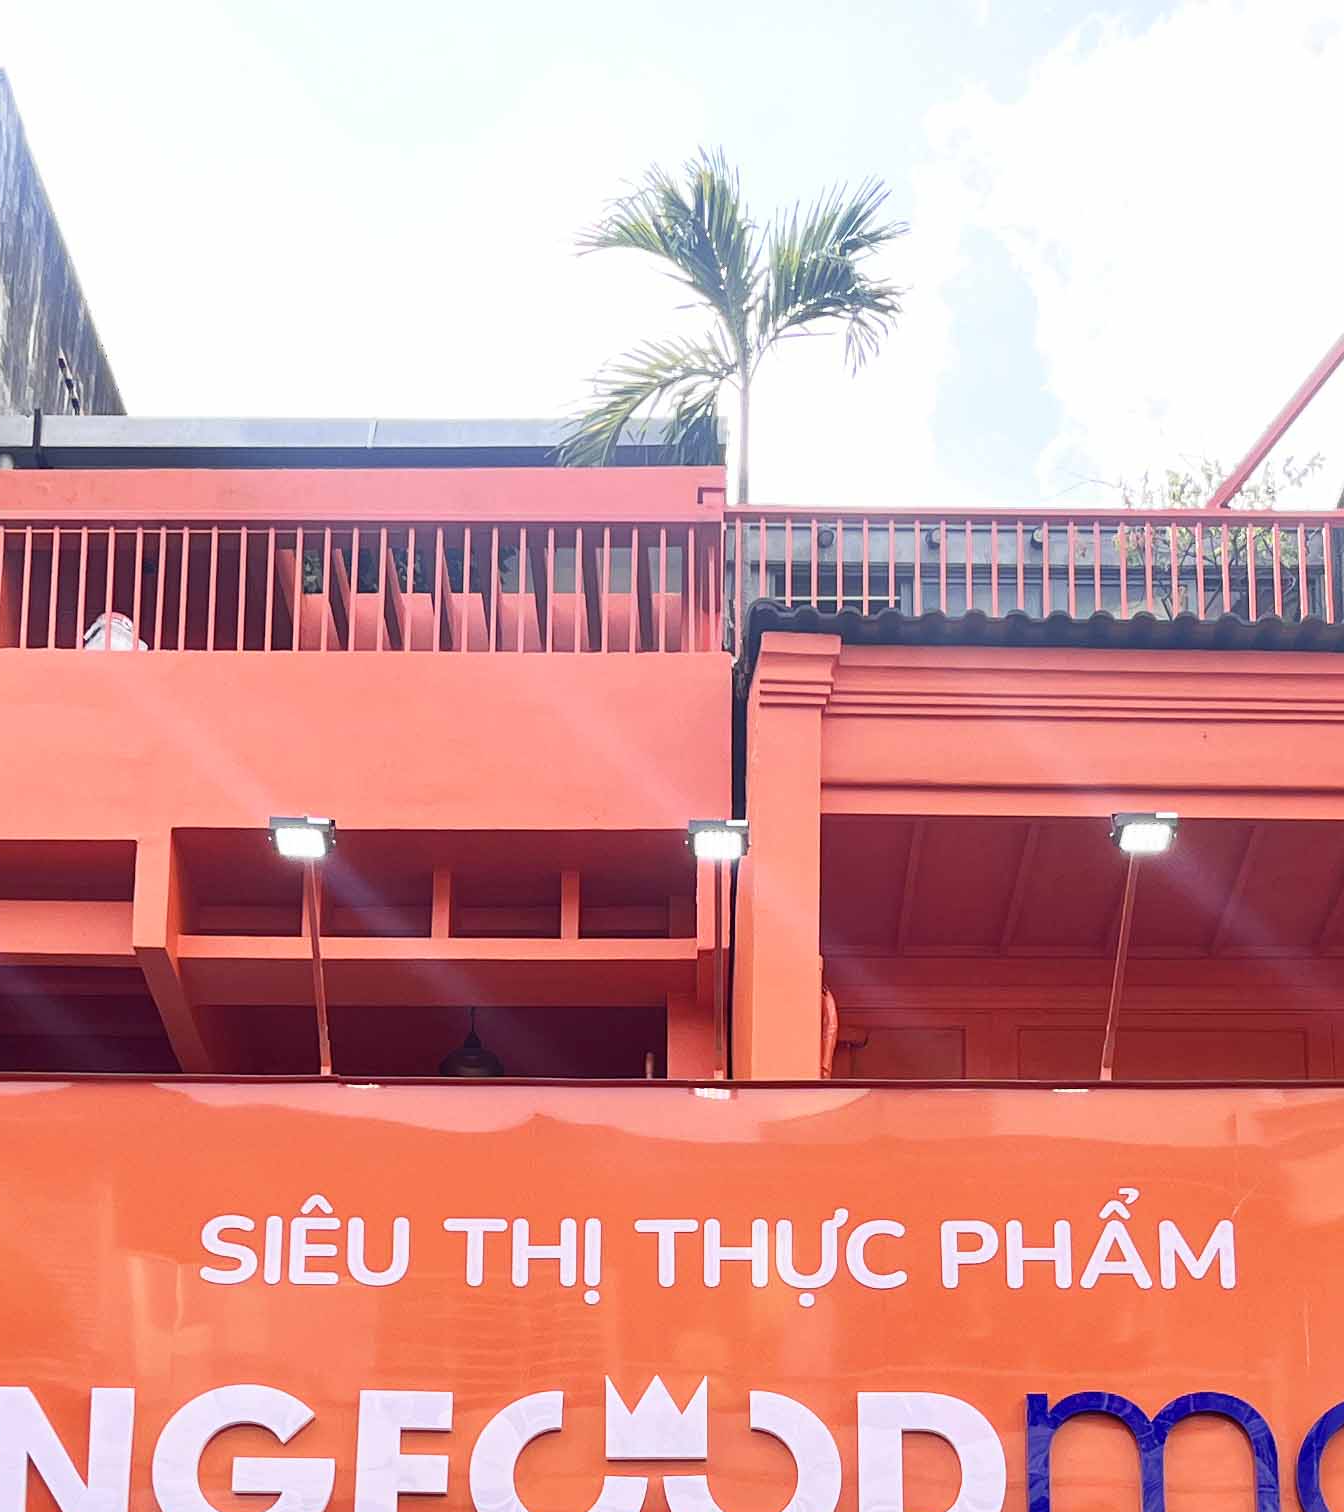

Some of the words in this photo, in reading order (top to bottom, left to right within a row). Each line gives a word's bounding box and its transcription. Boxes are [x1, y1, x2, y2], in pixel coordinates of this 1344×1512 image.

[199, 1194, 411, 1287] SIÊU
[443, 1216, 602, 1305] THỊ
[634, 1207, 907, 1307] THỰC
[940, 1187, 1238, 1289] PHẨM
